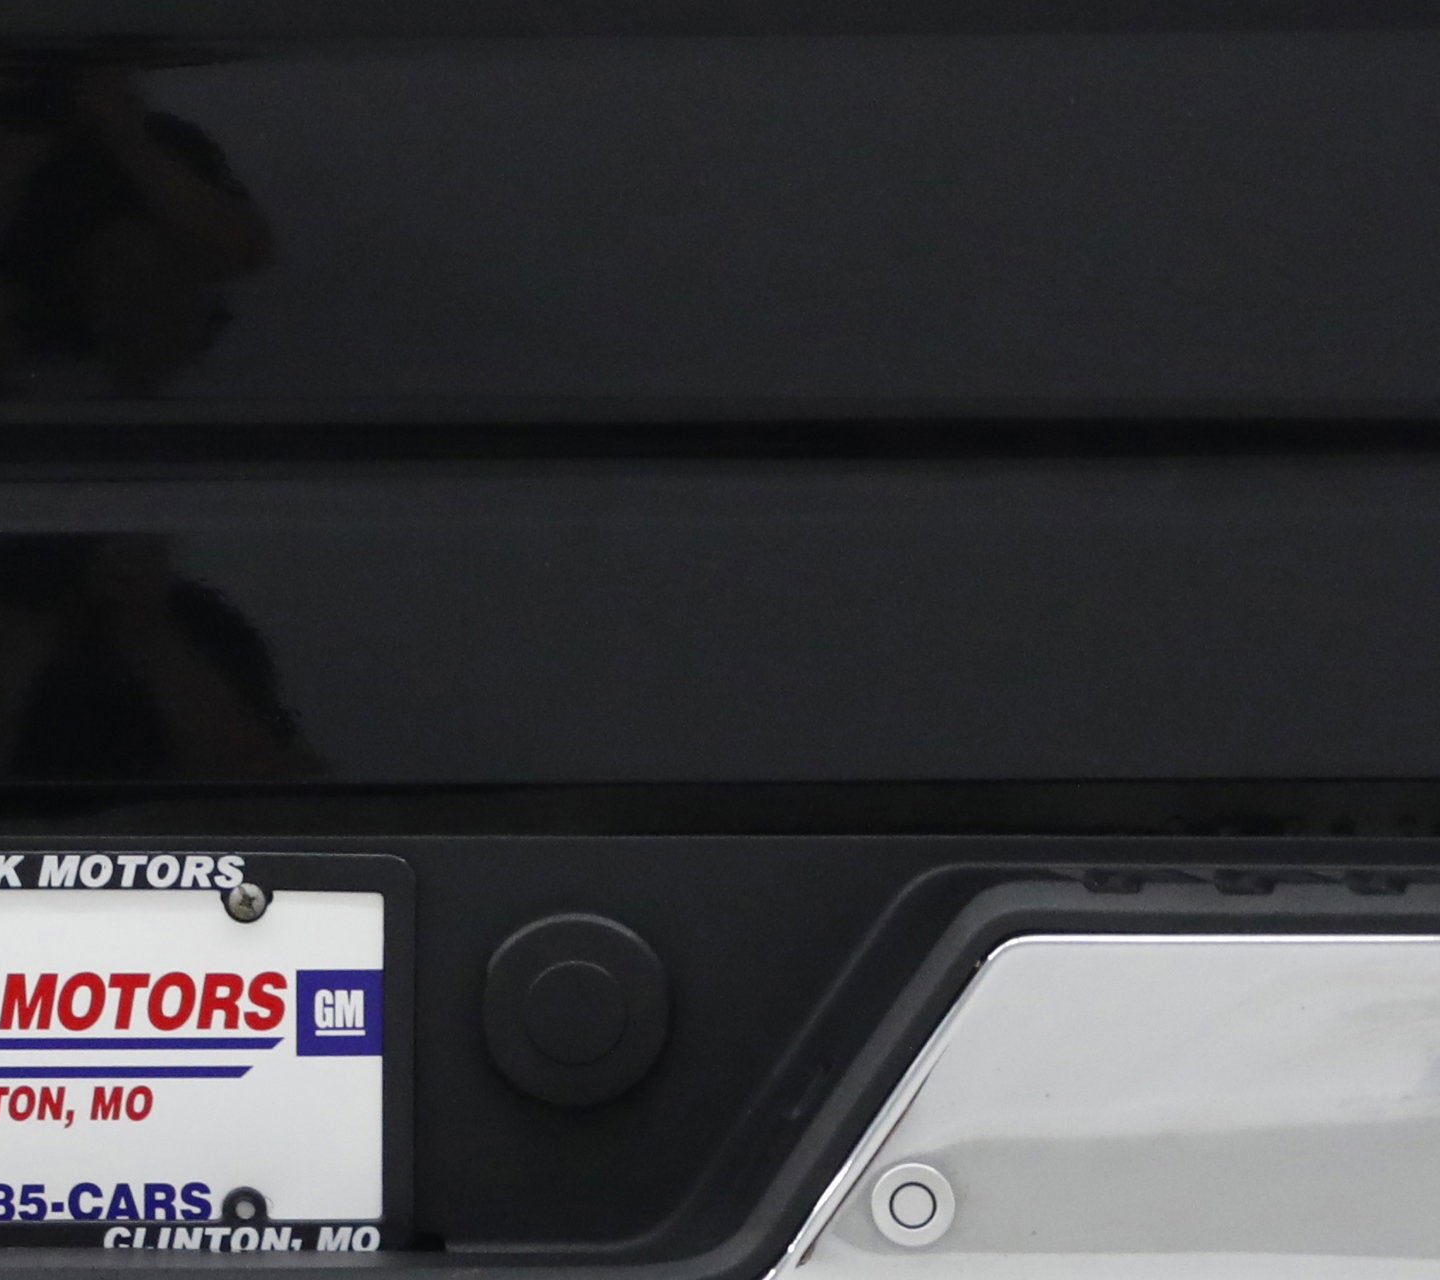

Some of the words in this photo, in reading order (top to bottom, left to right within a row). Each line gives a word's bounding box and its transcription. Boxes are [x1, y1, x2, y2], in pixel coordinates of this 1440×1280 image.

[37, 854, 246, 889] MOTORS
[0, 972, 288, 1031] MOTORS
[313, 988, 366, 1030] GM
[91, 1085, 154, 1121] MO
[103, 1226, 303, 1252] CLINTON,
[316, 1226, 381, 1252] MO
